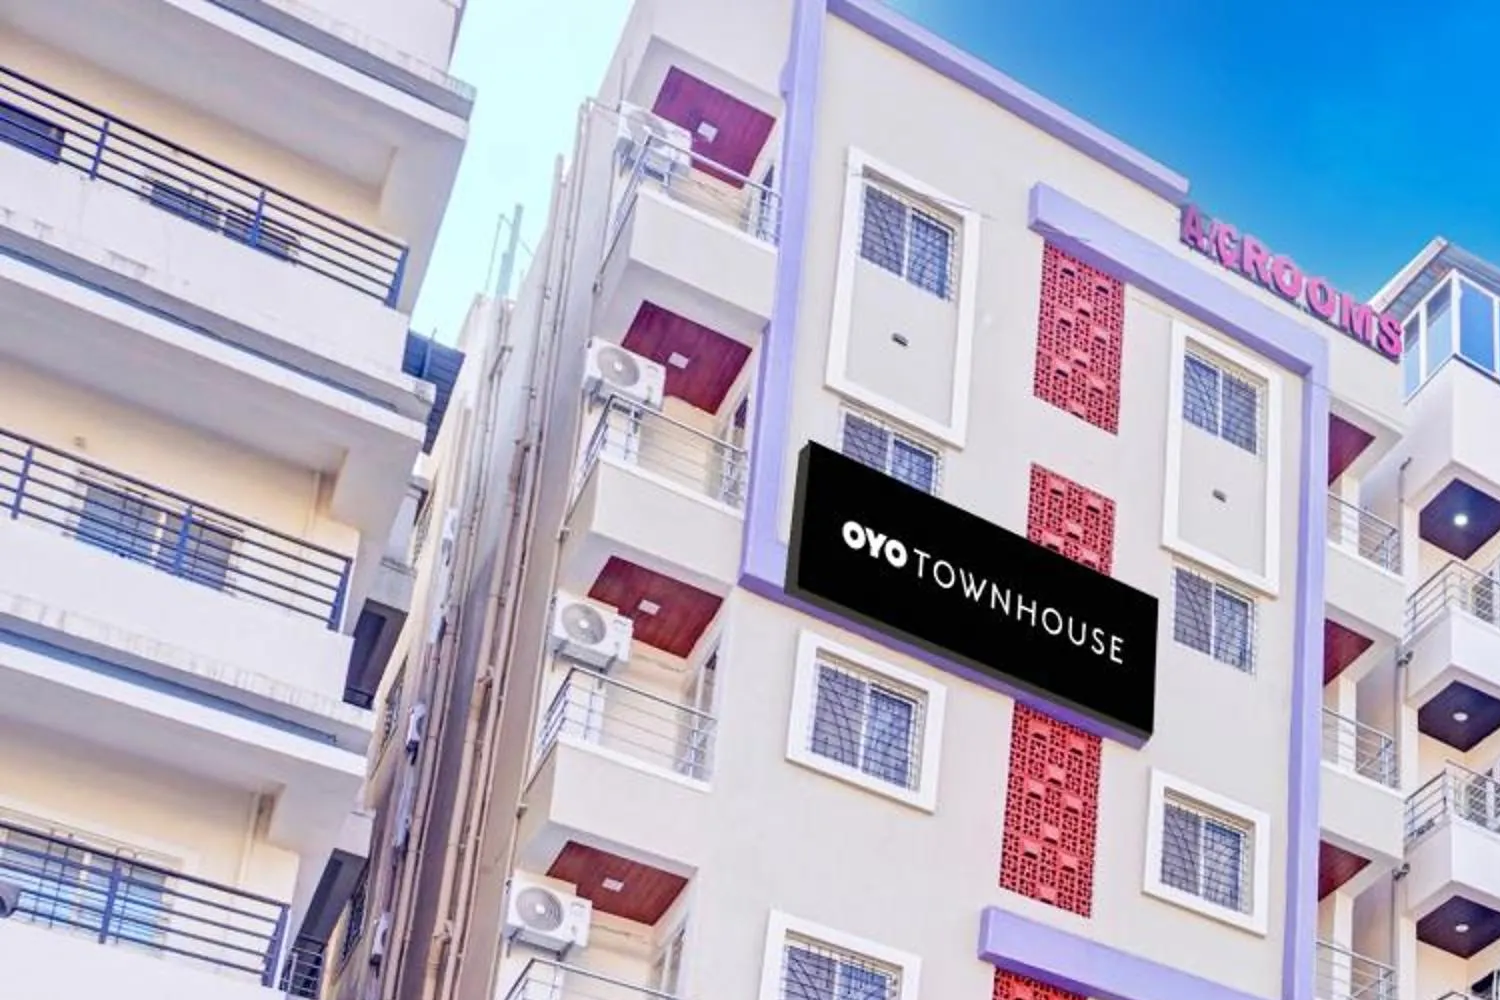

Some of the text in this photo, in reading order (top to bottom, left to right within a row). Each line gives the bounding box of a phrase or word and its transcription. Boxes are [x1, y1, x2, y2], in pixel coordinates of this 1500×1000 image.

[1240, 235, 1404, 364] ROOMS
[841, 520, 1125, 664] OYO TOWNHOUSE
